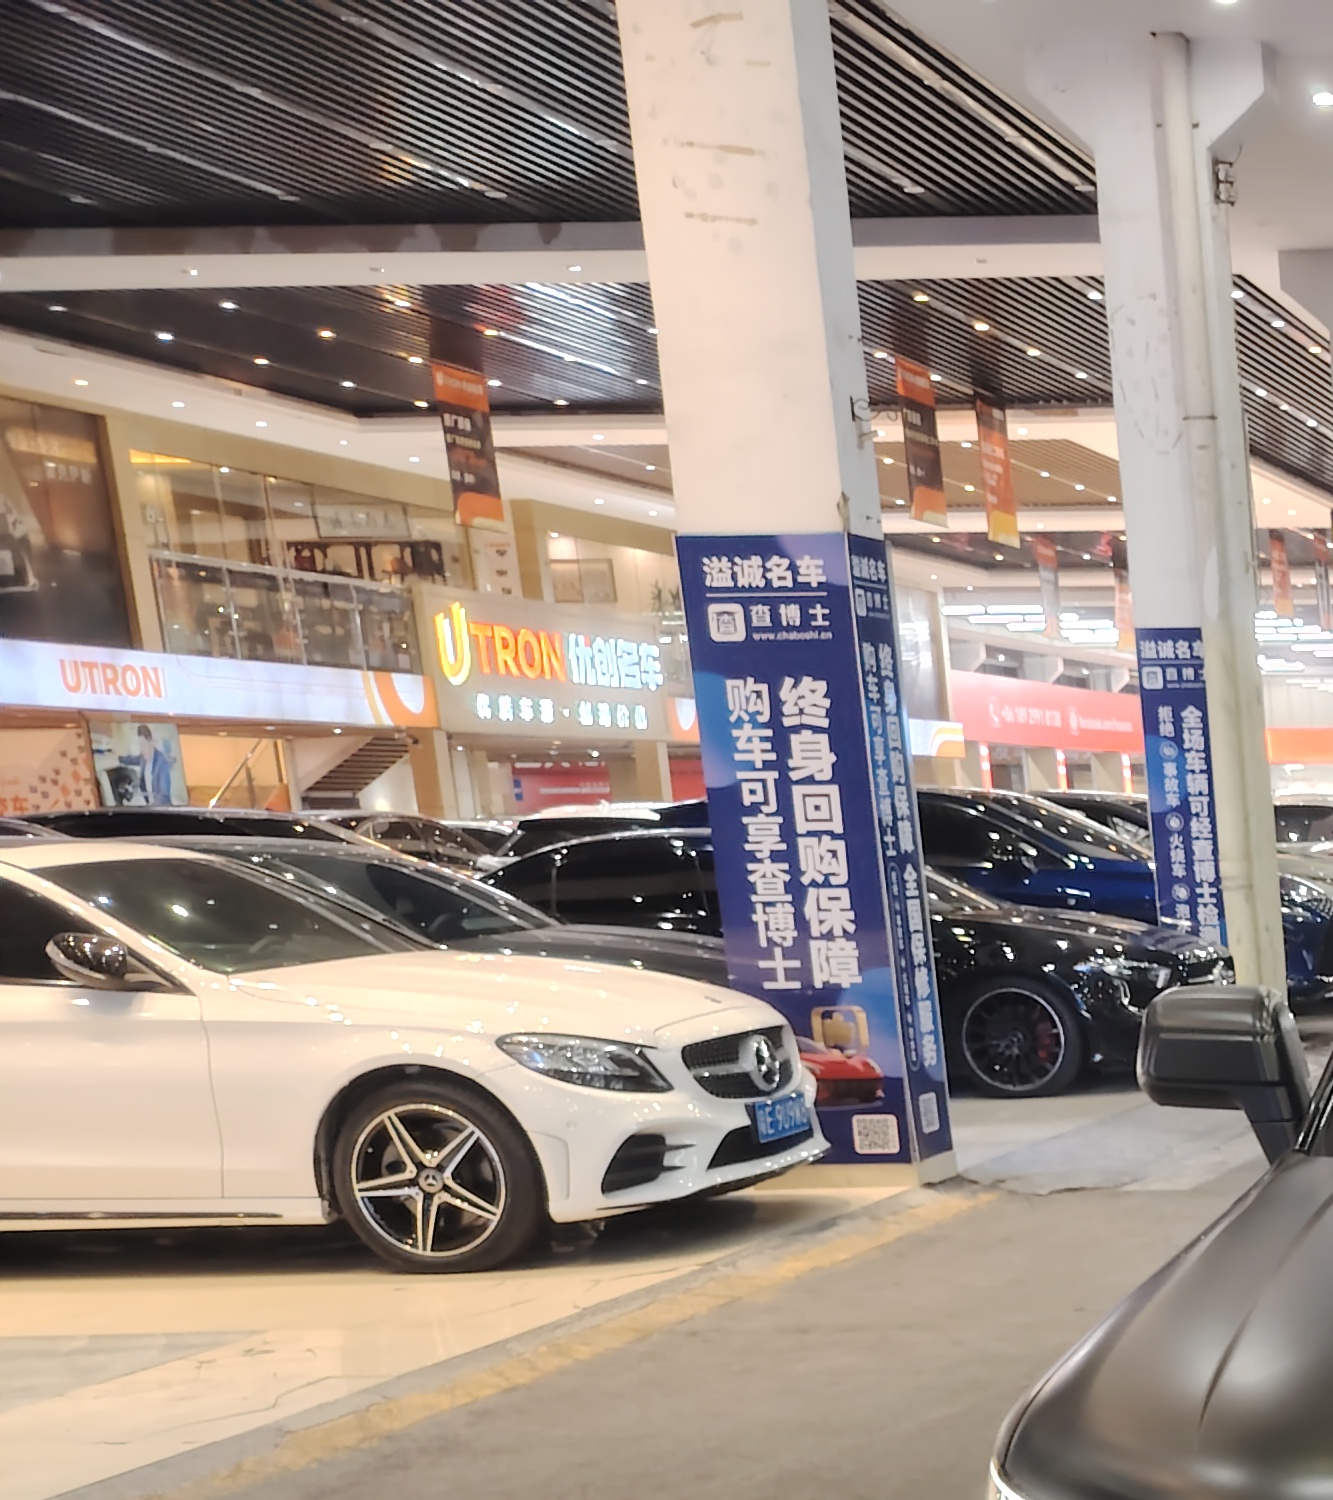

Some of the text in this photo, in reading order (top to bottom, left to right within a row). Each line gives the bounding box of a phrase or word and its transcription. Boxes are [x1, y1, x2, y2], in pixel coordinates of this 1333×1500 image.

[702, 554, 827, 588] 溢诚名车
[434, 601, 567, 686] UTRON
[749, 603, 830, 627] 查博士
[59, 658, 164, 698] UTRON
[725, 675, 802, 990] 购车可享查博士
[779, 675, 863, 989] 终身回购保障
